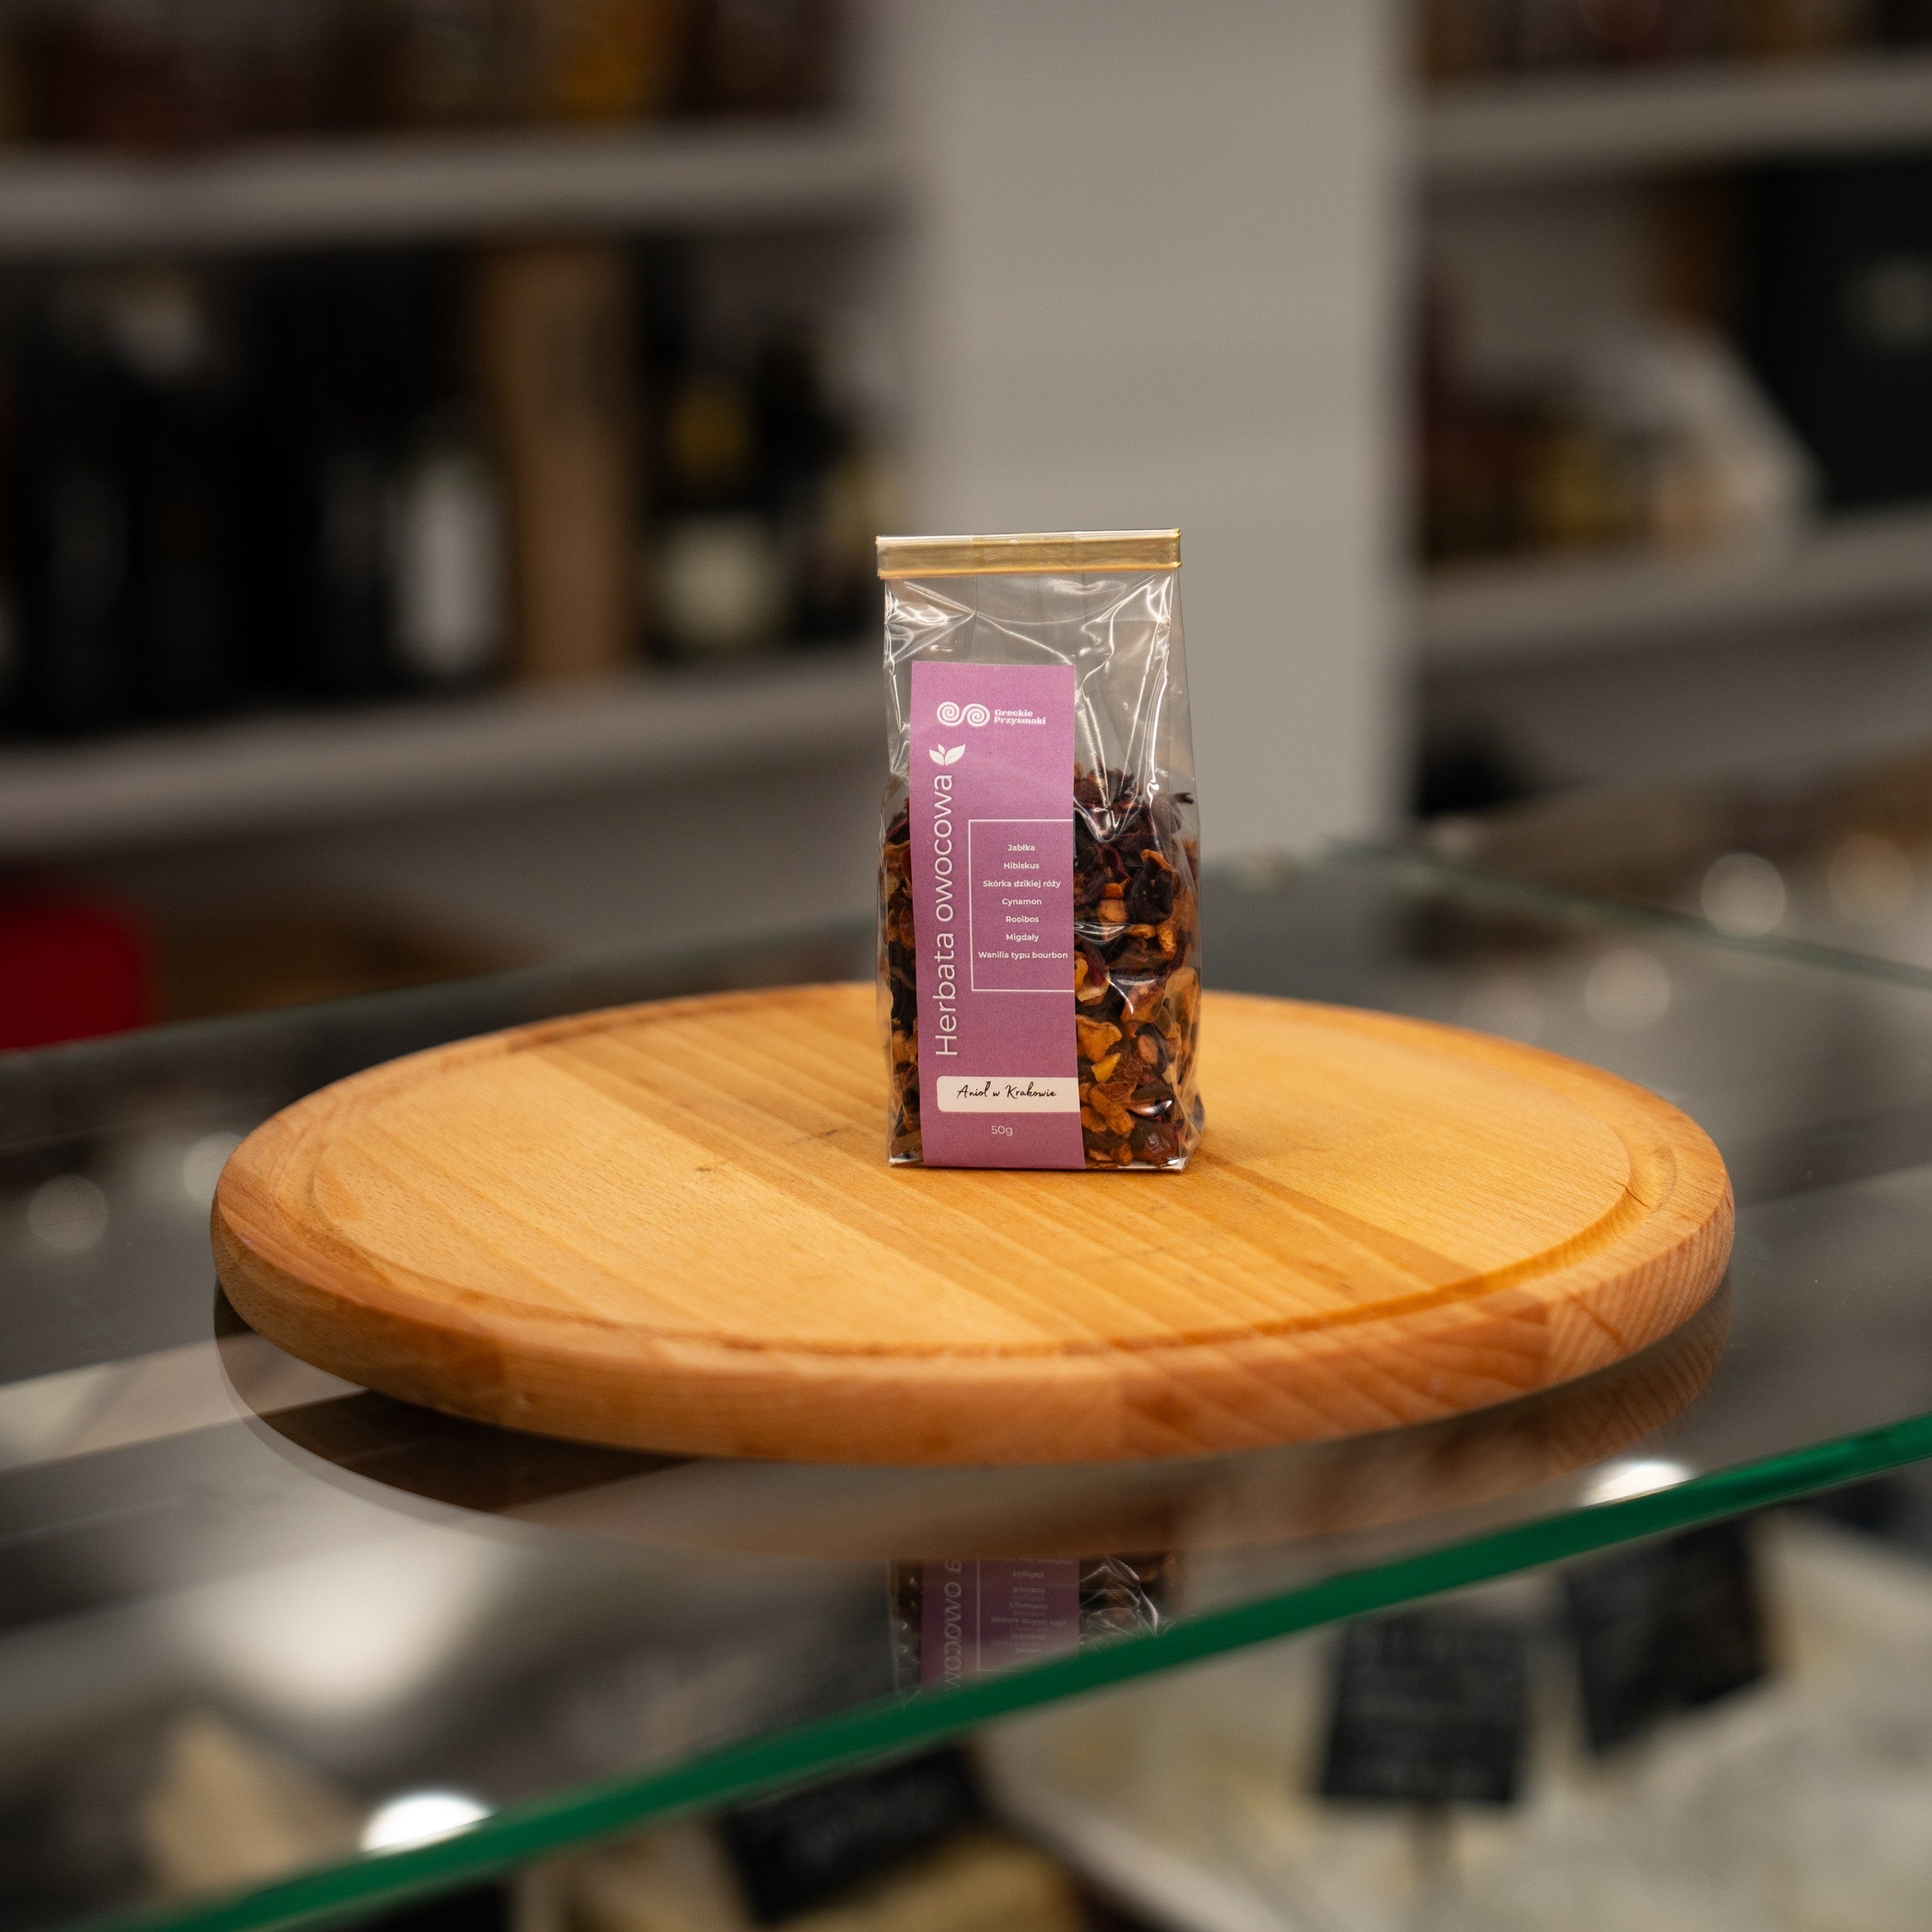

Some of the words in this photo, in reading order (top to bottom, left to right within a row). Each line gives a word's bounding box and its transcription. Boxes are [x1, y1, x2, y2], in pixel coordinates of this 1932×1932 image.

[994, 709, 1033, 717] Greckie
[994, 716, 1046, 725] Przysmaki
[934, 774, 953, 922] owocowa
[1013, 879, 1041, 888] dzikiej
[1043, 879, 1061, 888] róży
[1005, 934, 1039, 942] Migdały
[1011, 951, 1030, 960] typu
[933, 933, 957, 1056] Herbata
[1005, 1081, 1057, 1099] Krakowie
[991, 1125, 1013, 1136] 50g
